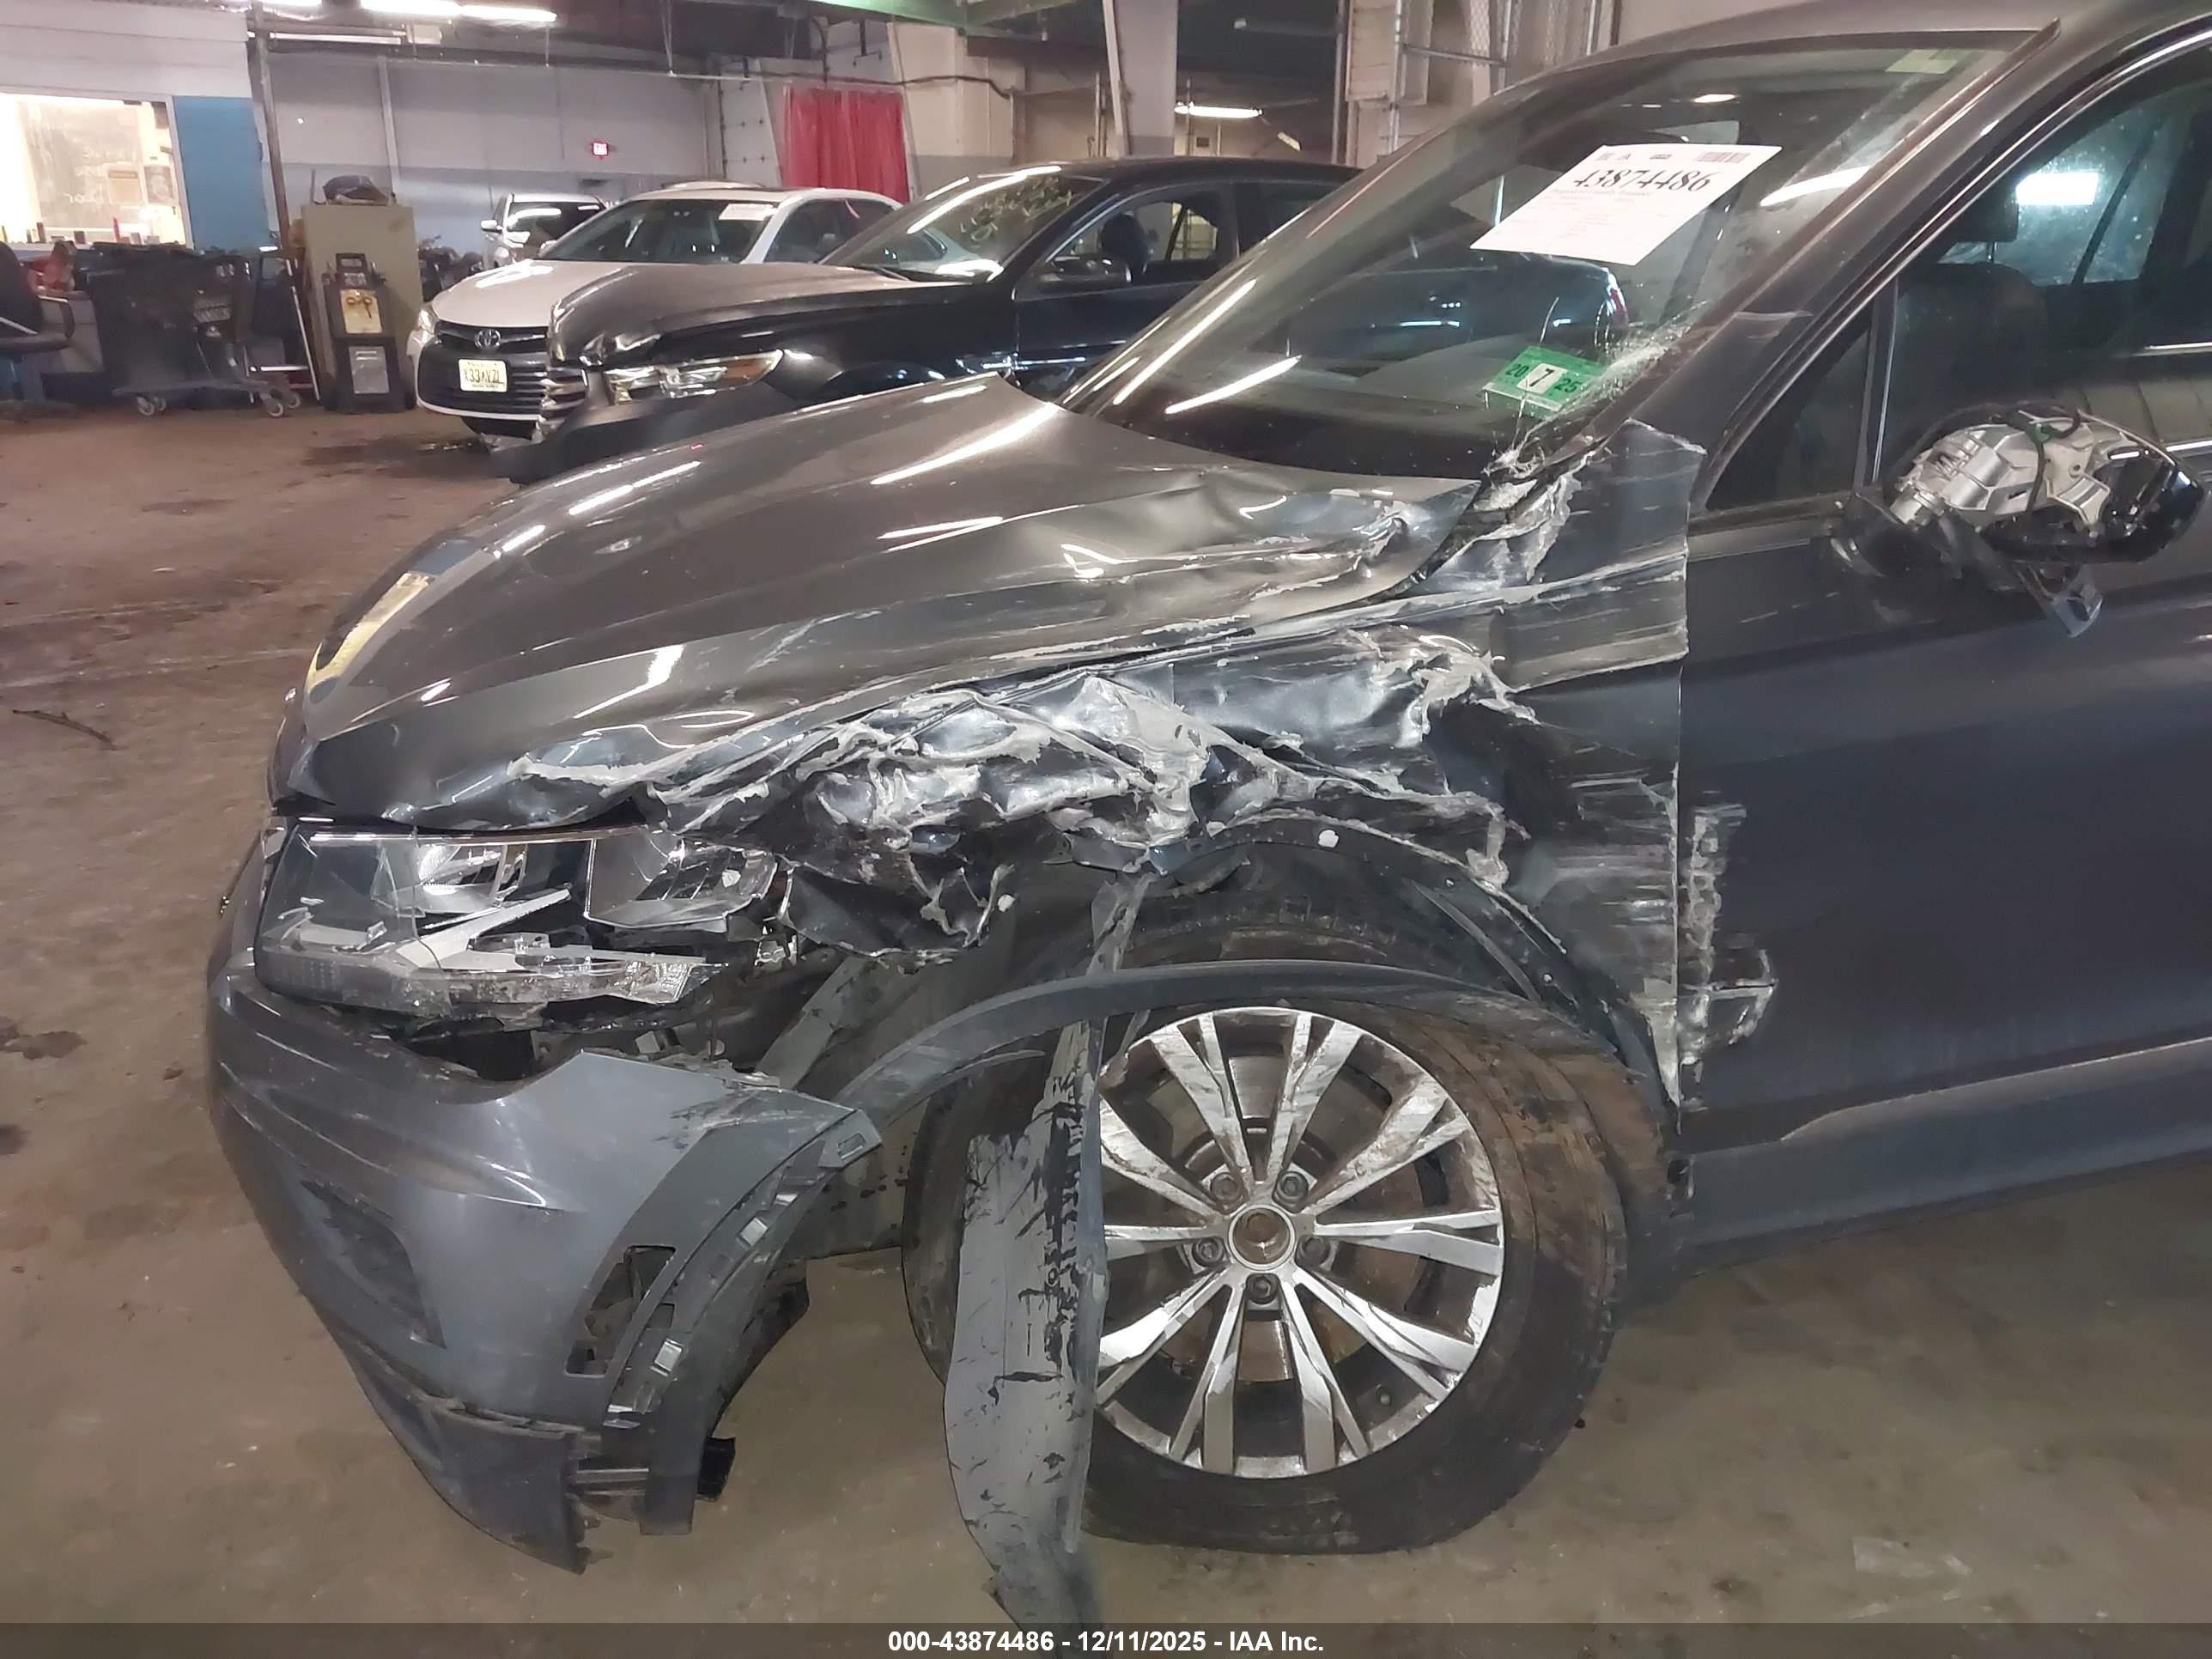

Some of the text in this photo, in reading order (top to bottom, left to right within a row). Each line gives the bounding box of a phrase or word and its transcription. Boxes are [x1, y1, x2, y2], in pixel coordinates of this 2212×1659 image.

[1573, 168, 1717, 192] 43874486
[1504, 363, 1529, 378] 20
[1529, 368, 1555, 387] 7
[1554, 378, 1581, 393] 25
